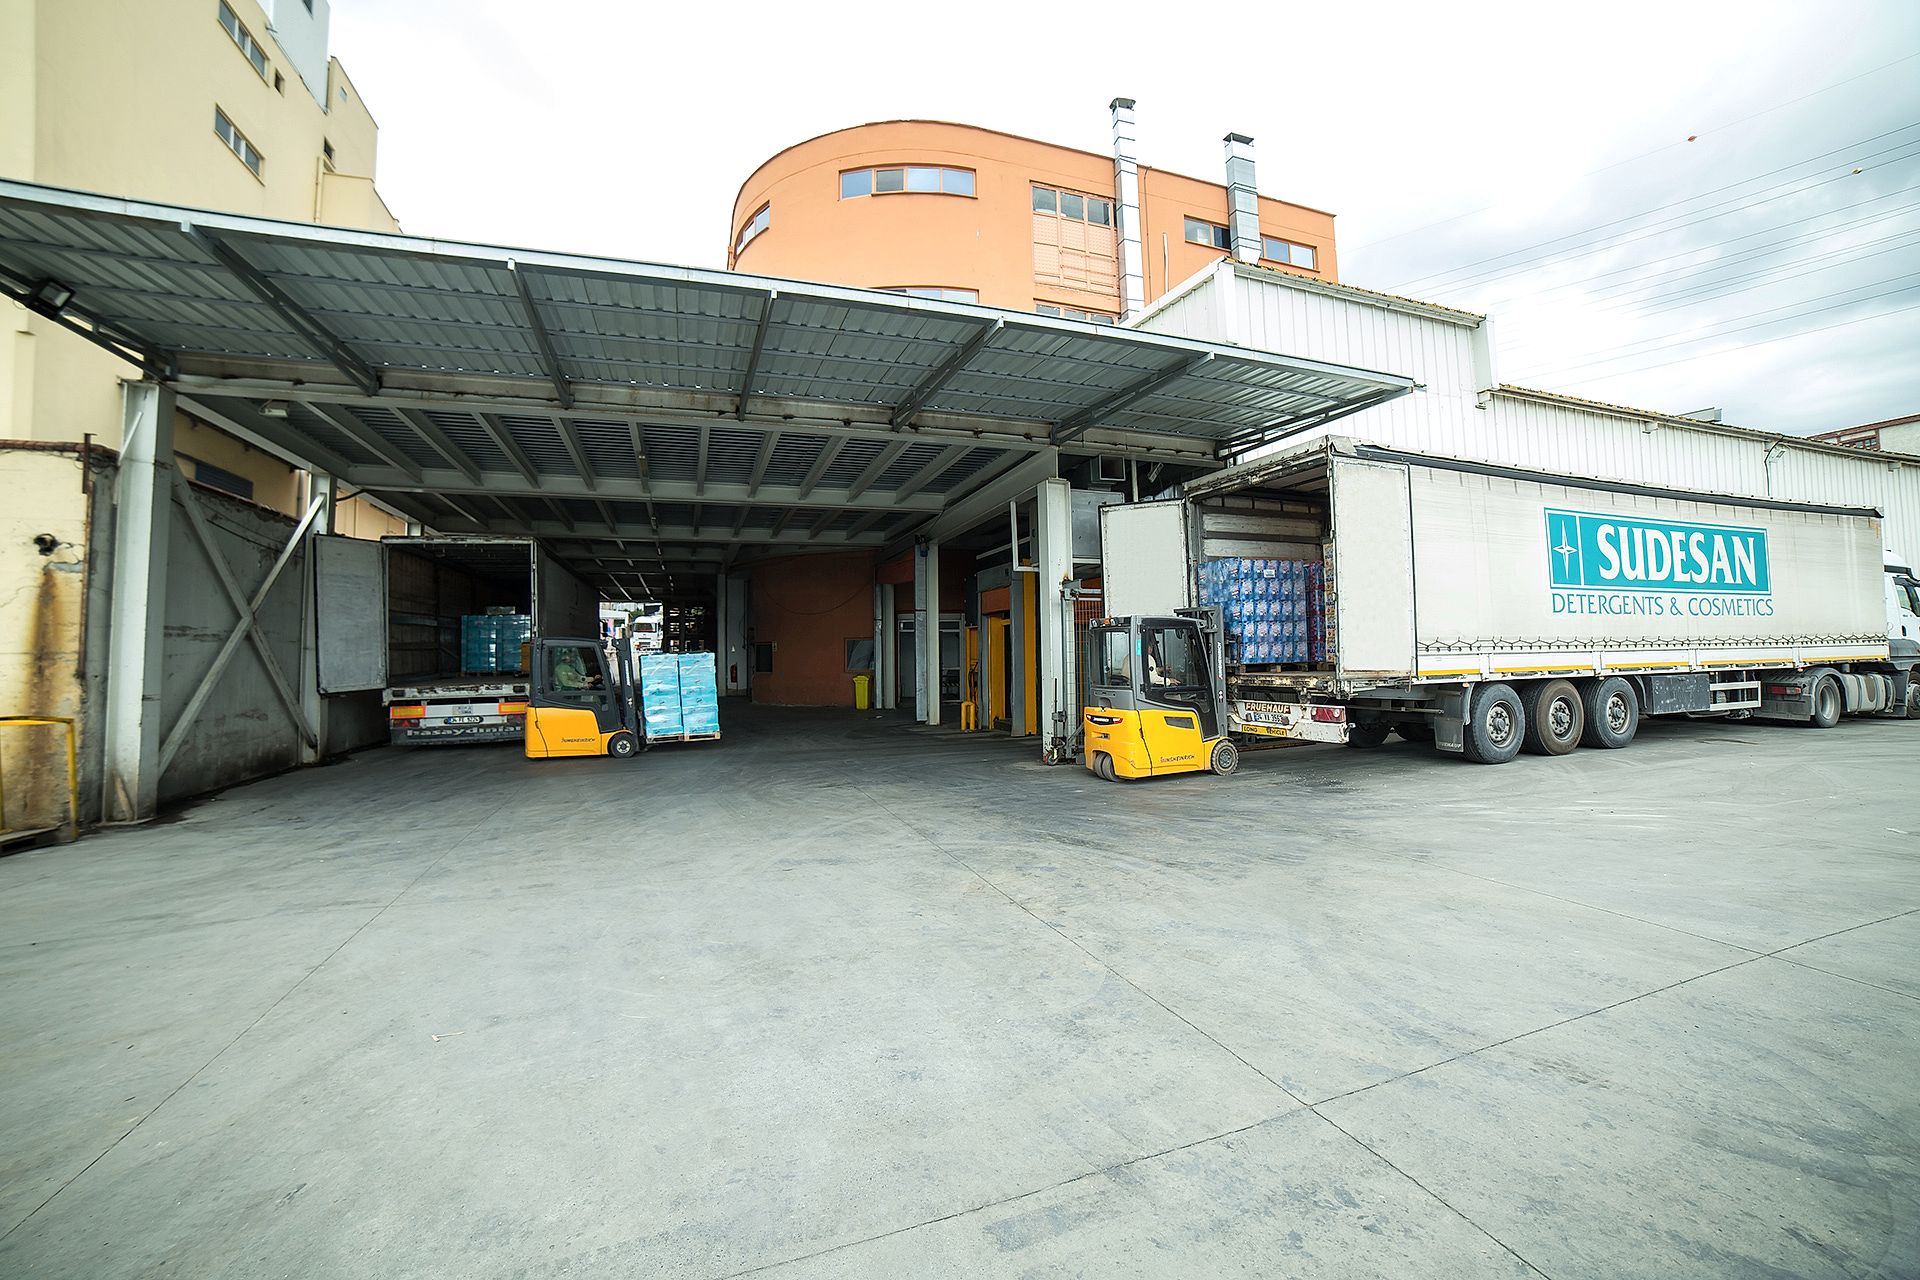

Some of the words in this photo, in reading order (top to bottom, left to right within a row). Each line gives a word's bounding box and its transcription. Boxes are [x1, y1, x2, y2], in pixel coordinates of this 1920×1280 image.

[1597, 523, 1757, 587] SUDESAN
[1551, 593, 1664, 616] DETERGENTS
[1669, 596, 1684, 617] &
[1688, 597, 1774, 617] COSMETICS
[1246, 702, 1290, 714] FRUEHAUF
